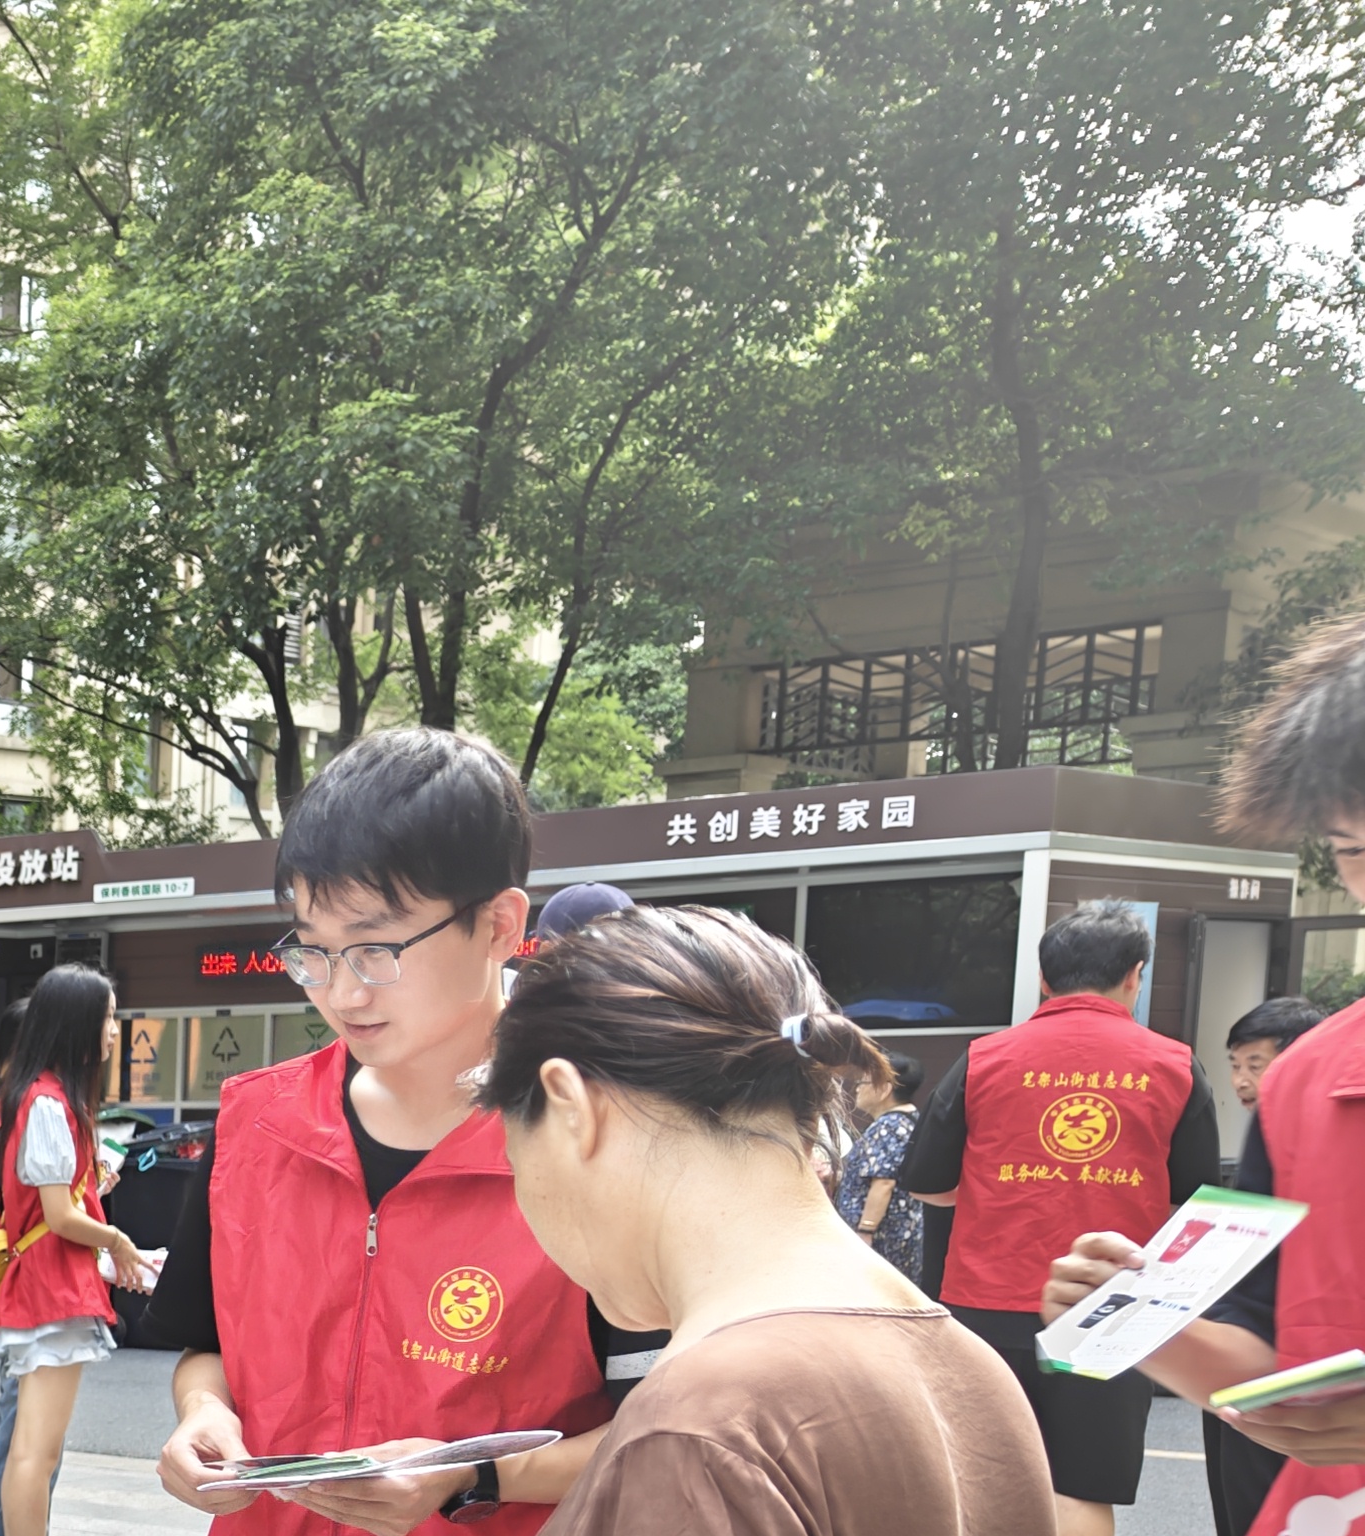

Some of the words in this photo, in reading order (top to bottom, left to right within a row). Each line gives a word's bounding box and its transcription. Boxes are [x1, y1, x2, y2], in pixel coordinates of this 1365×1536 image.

[667, 795, 916, 846] 共创美好家园
[201, 952, 237, 975] 出来
[1022, 1070, 1150, 1092] 笔架山街道志愿者
[997, 1163, 1069, 1183] 服务他人
[1077, 1163, 1145, 1187] 奉献社会
